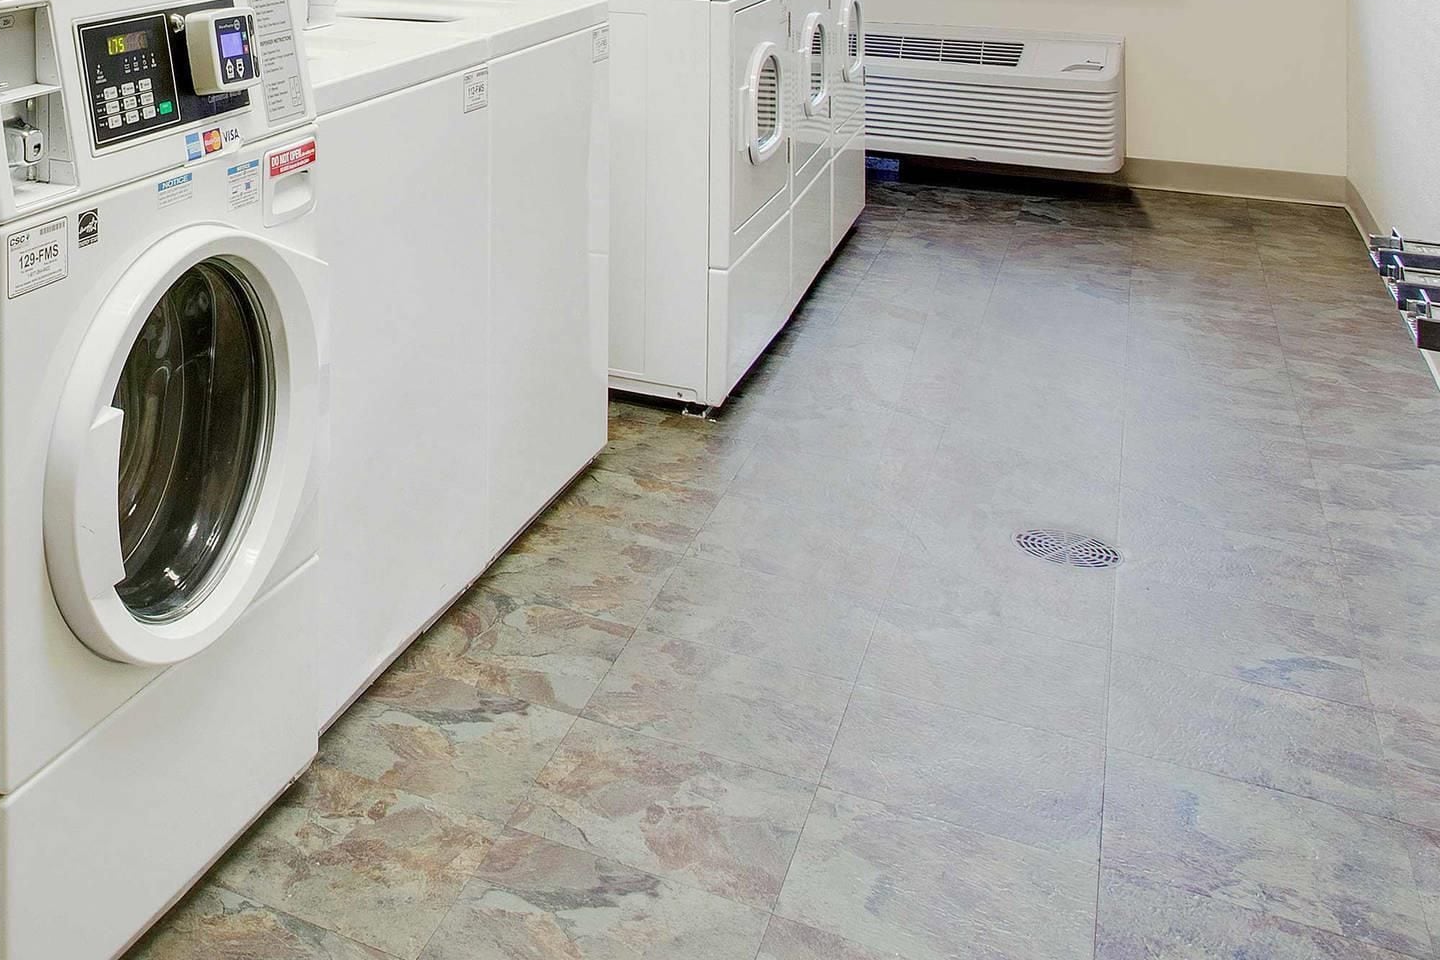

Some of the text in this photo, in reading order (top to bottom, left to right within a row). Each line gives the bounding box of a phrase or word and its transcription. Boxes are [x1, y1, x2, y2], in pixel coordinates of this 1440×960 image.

[223, 128, 240, 142] VISA
[162, 175, 189, 190] NOTICE
[19, 244, 59, 270] 129-FMS
